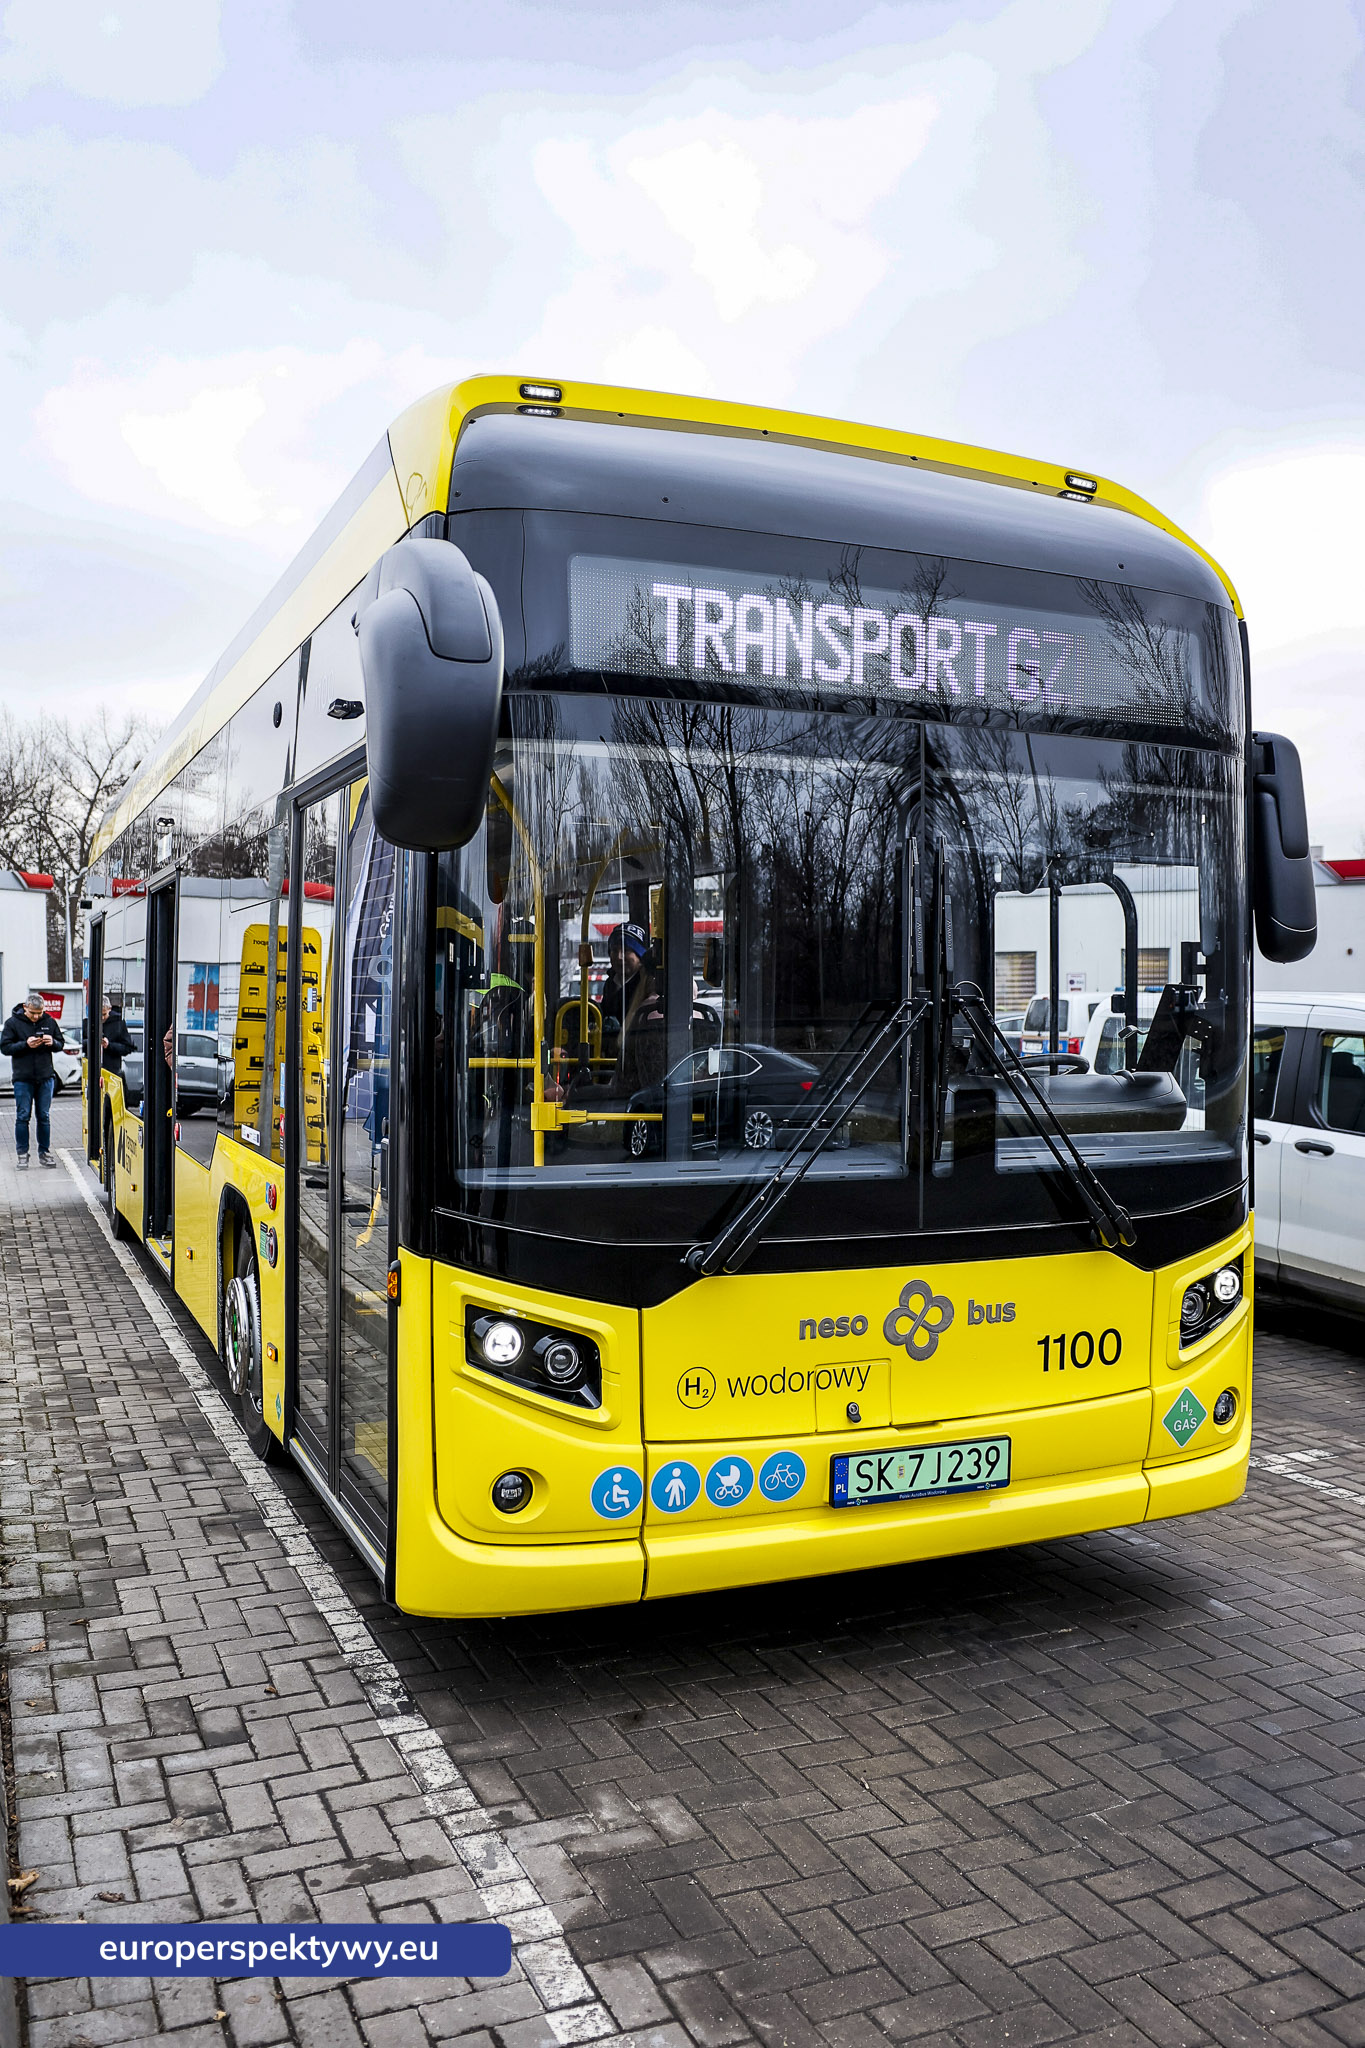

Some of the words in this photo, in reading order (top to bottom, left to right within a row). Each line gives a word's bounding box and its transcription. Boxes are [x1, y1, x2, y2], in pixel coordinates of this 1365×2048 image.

[652, 582, 997, 697] TRANSPORT
[799, 1314, 869, 1341] neso
[967, 1298, 1016, 1325] bus
[1037, 1327, 1122, 1373] 1100
[727, 1364, 871, 1399] wodorowy
[1173, 1417, 1198, 1432] GAS
[835, 1483, 847, 1494] PL
[855, 1456, 895, 1494] SK
[908, 1445, 1001, 1488] 7J239
[927, 1489, 948, 1497] Wodorowy
